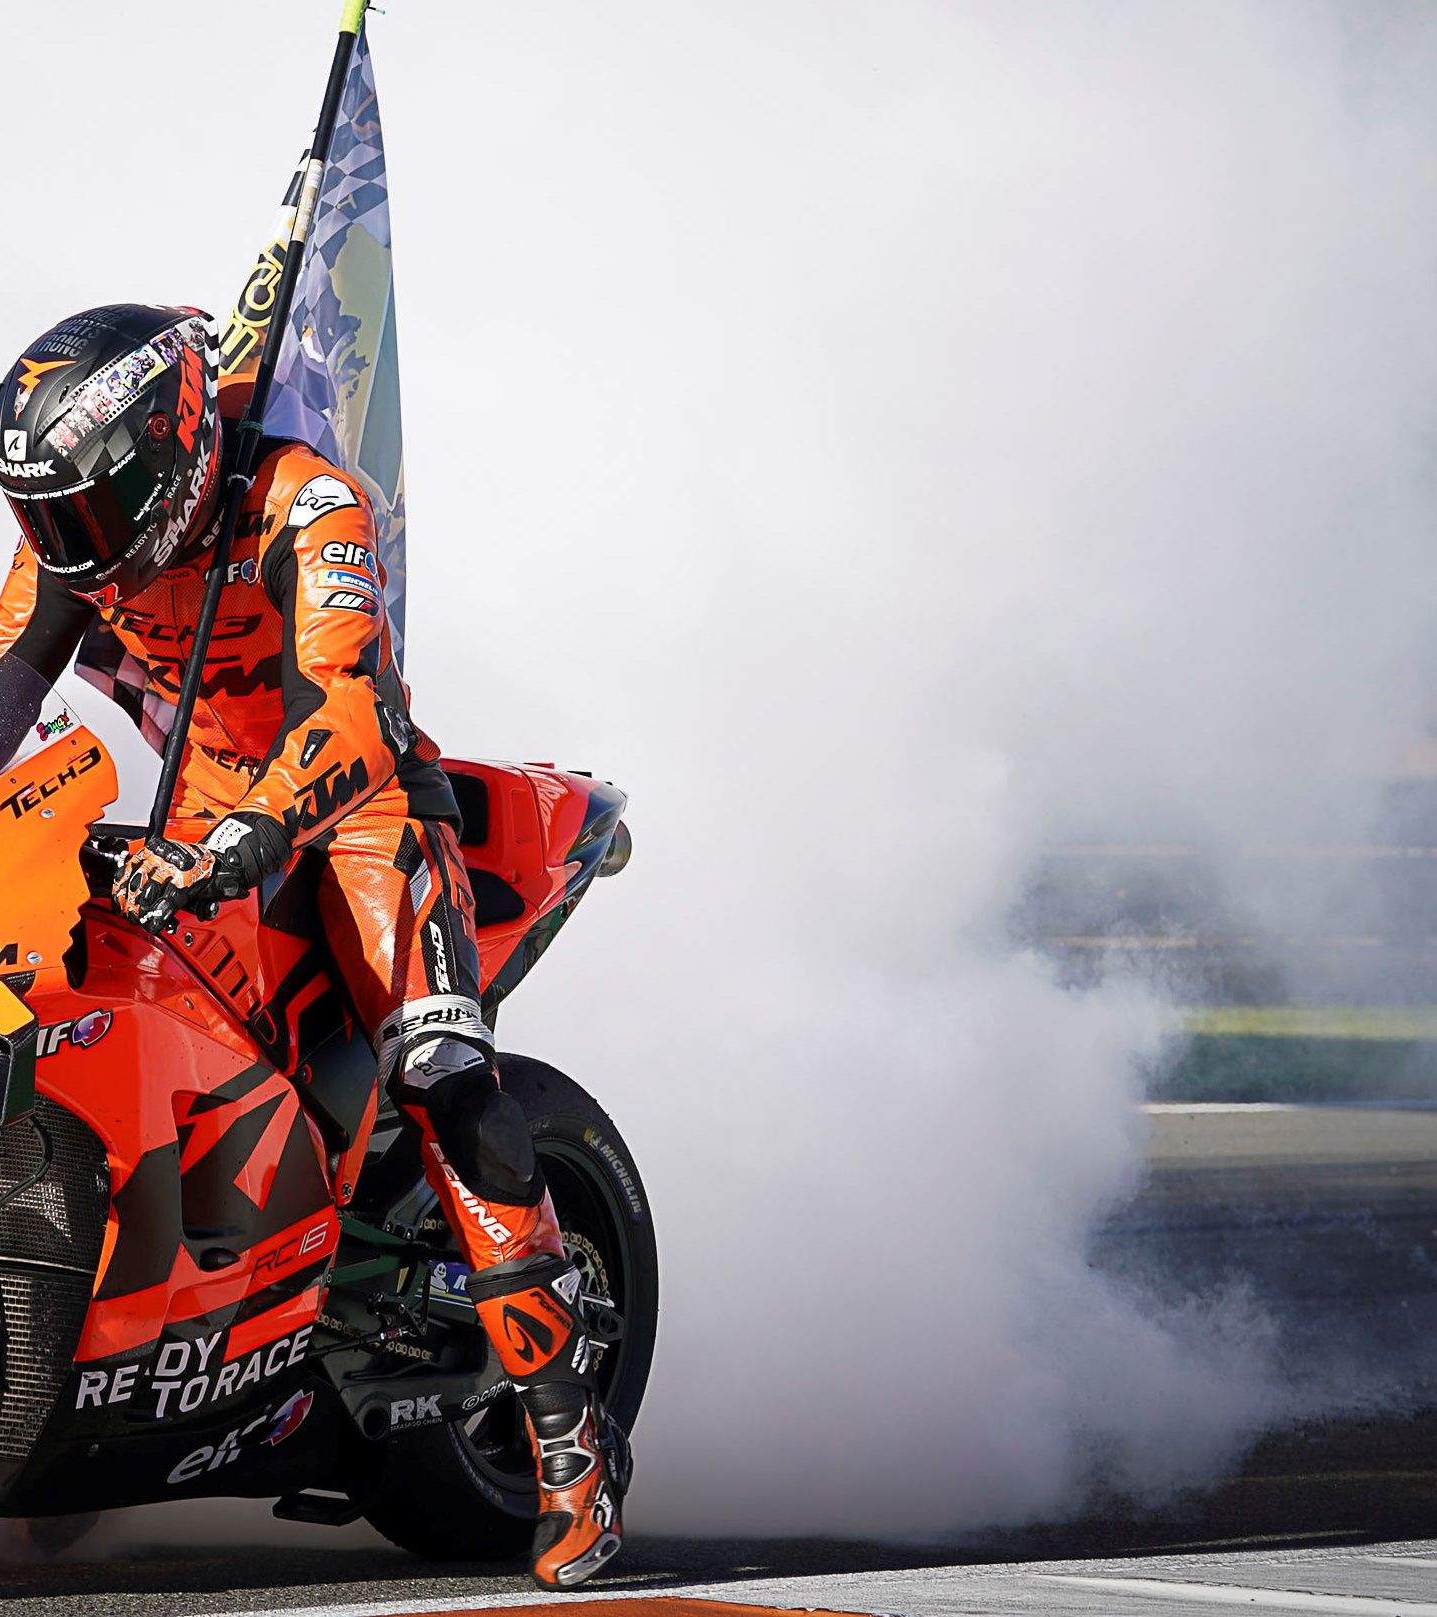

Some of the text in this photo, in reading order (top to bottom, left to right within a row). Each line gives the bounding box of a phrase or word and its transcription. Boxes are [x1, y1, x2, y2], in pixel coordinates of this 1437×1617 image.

[176, 343, 204, 454] KTM
[108, 449, 137, 477] SHARK
[125, 533, 149, 559] READY
[167, 474, 182, 499] RACE
[153, 440, 212, 567] SHARK
[322, 542, 366, 566] elf
[0, 746, 103, 820] TECH3
[283, 756, 369, 839] KTM
[429, 920, 452, 994] TECH3
[601, 1144, 643, 1214] MICHELIN
[151, 1326, 314, 1419] TO RACE
[390, 1393, 443, 1425] RK
